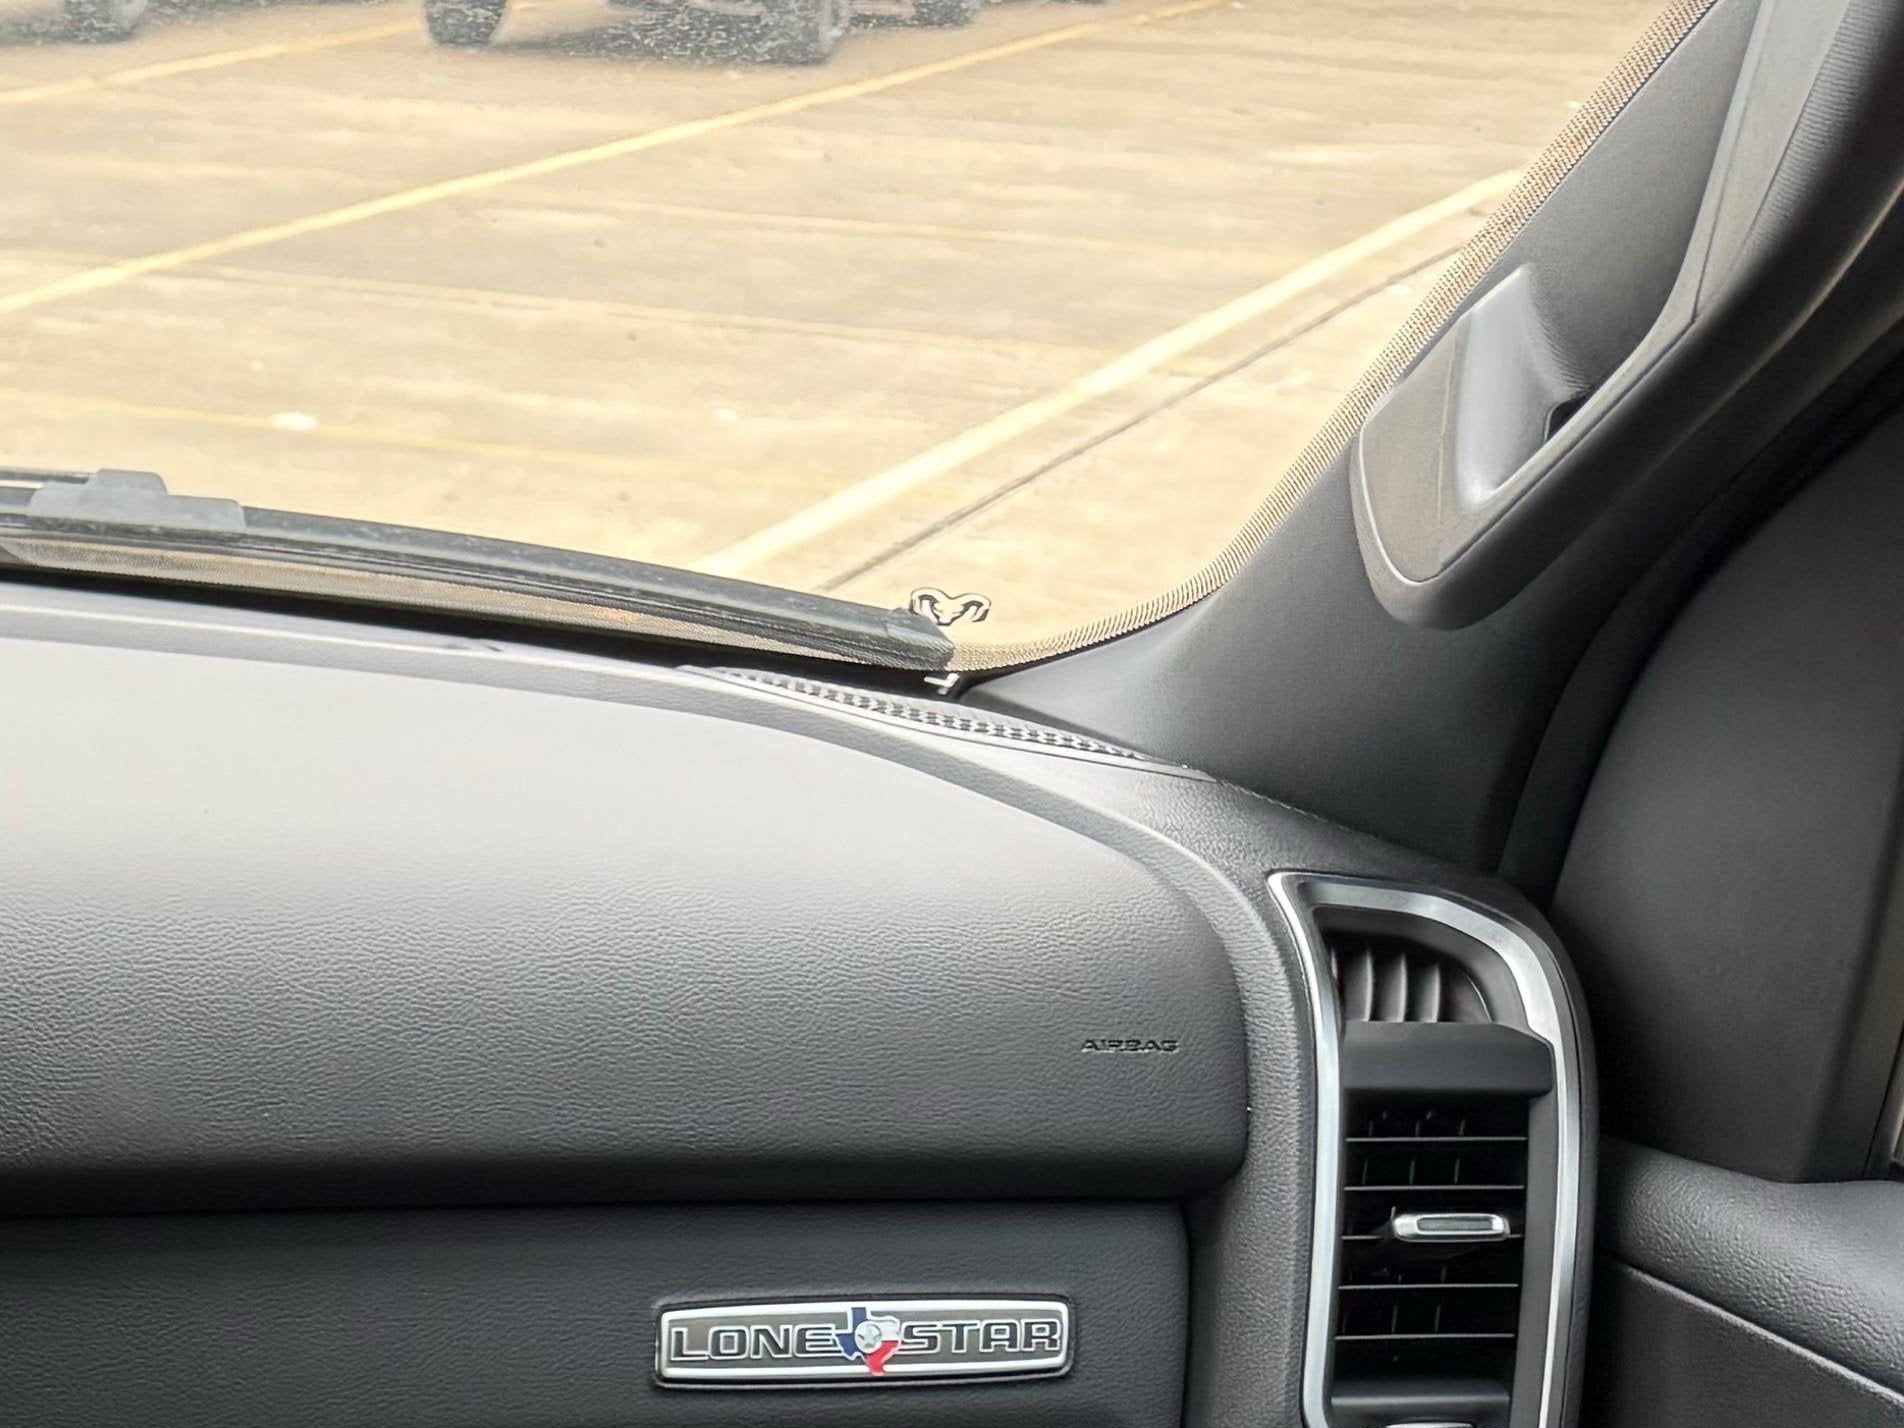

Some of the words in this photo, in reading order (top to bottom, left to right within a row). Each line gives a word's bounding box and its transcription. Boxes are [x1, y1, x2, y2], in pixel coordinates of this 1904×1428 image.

[1081, 1039, 1180, 1053] AIRBAG
[670, 1324, 837, 1361] LONE
[901, 1318, 1061, 1354] STAR
